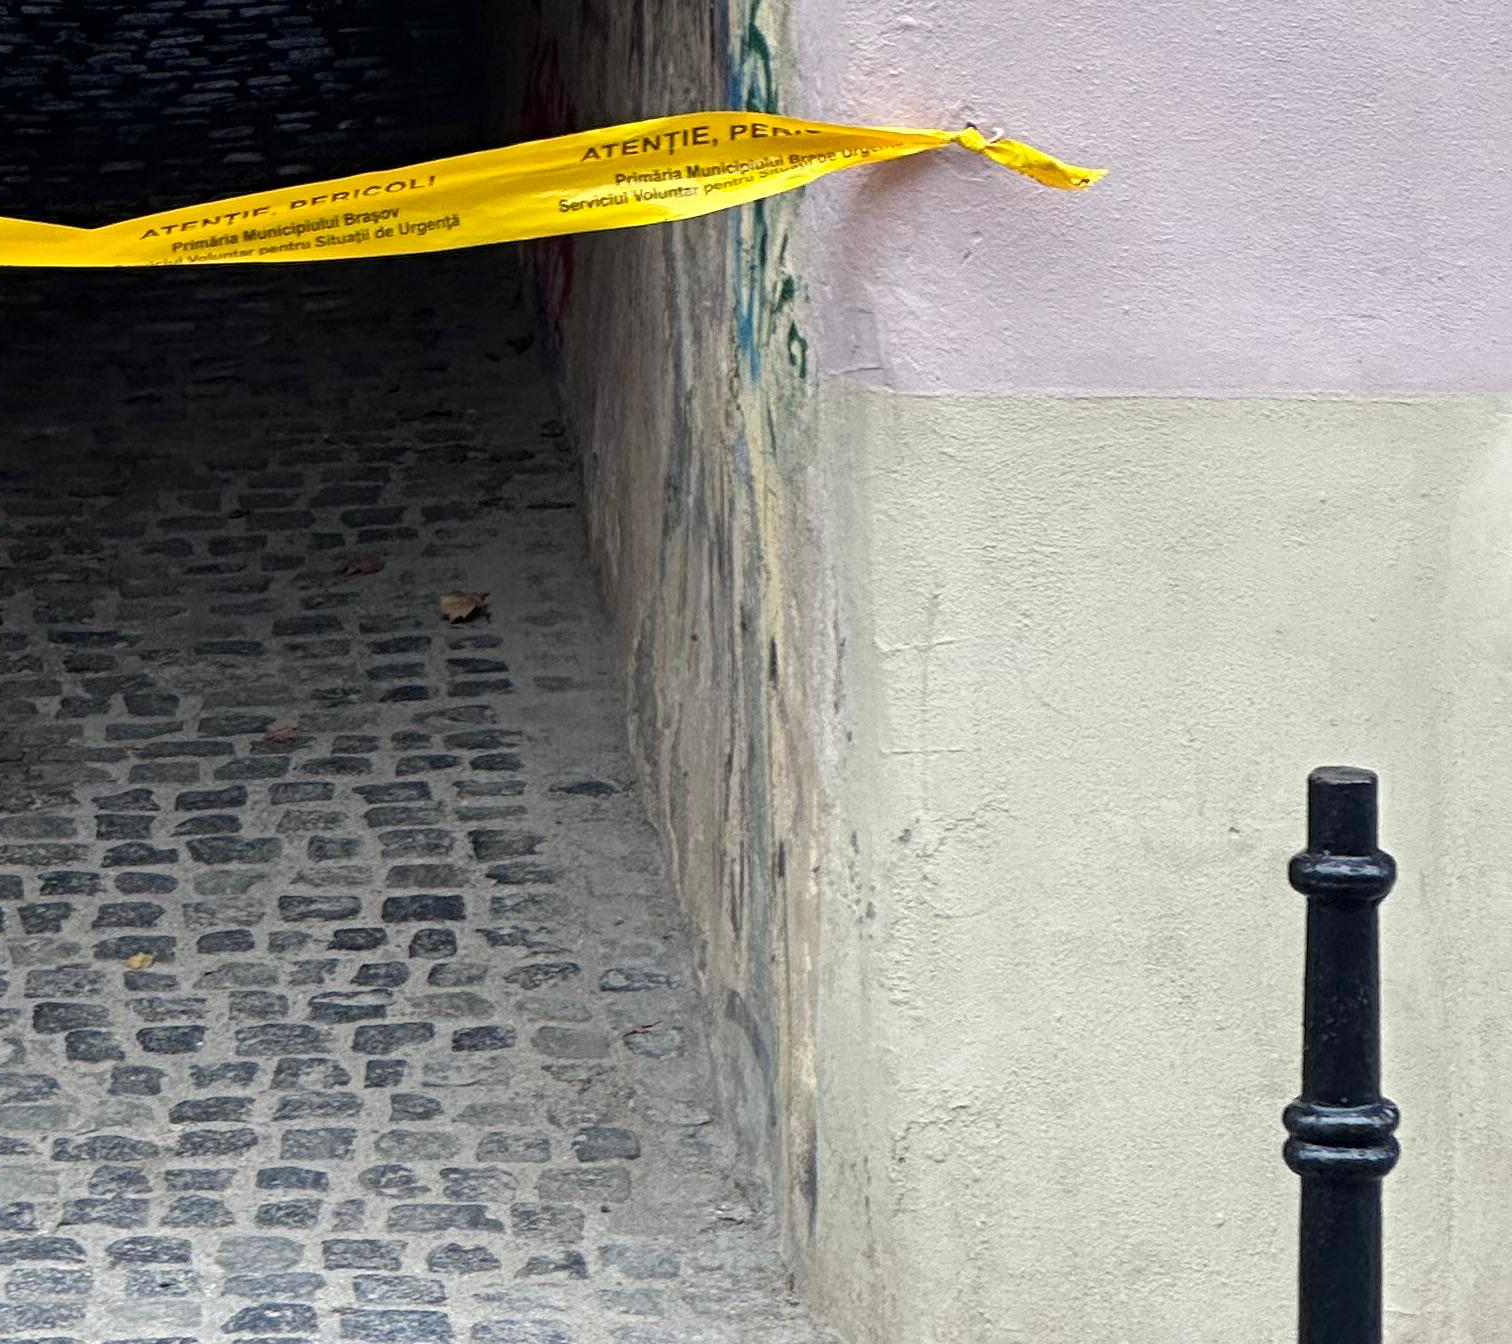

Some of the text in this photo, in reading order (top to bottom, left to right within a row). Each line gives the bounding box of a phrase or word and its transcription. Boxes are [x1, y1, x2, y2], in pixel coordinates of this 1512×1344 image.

[615, 168, 682, 187] Primăria
[558, 190, 630, 214] Serviciul
[171, 206, 401, 254] Primăria Municipiului Brașov
[315, 230, 371, 251] Situații
[374, 223, 394, 240] de
[398, 213, 461, 239] Urgență
